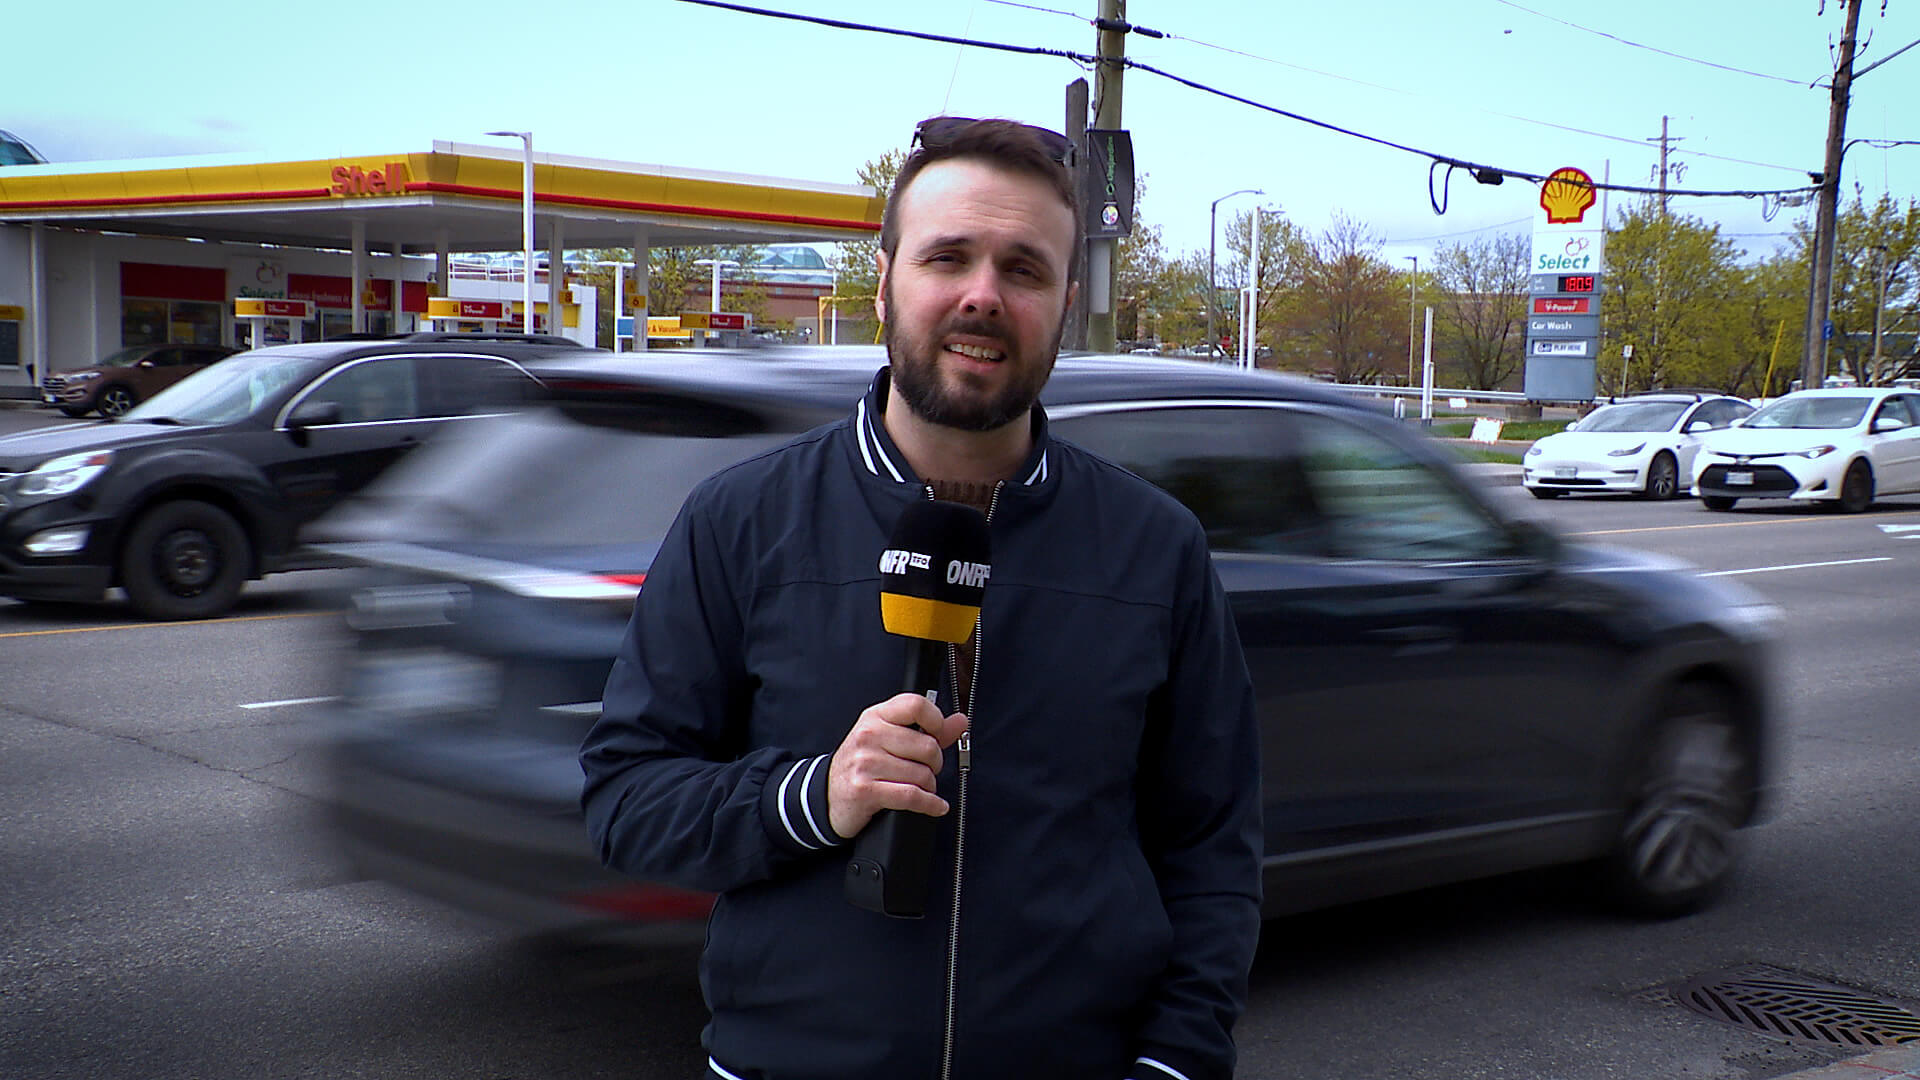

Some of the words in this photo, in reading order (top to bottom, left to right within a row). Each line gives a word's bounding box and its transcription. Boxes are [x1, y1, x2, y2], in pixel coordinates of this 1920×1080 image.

[332, 163, 406, 194] Shell
[1538, 254, 1590, 270] Select
[632, 297, 639, 306] 6
[1532, 321, 1545, 330] Car
[1547, 320, 1572, 330] Wash
